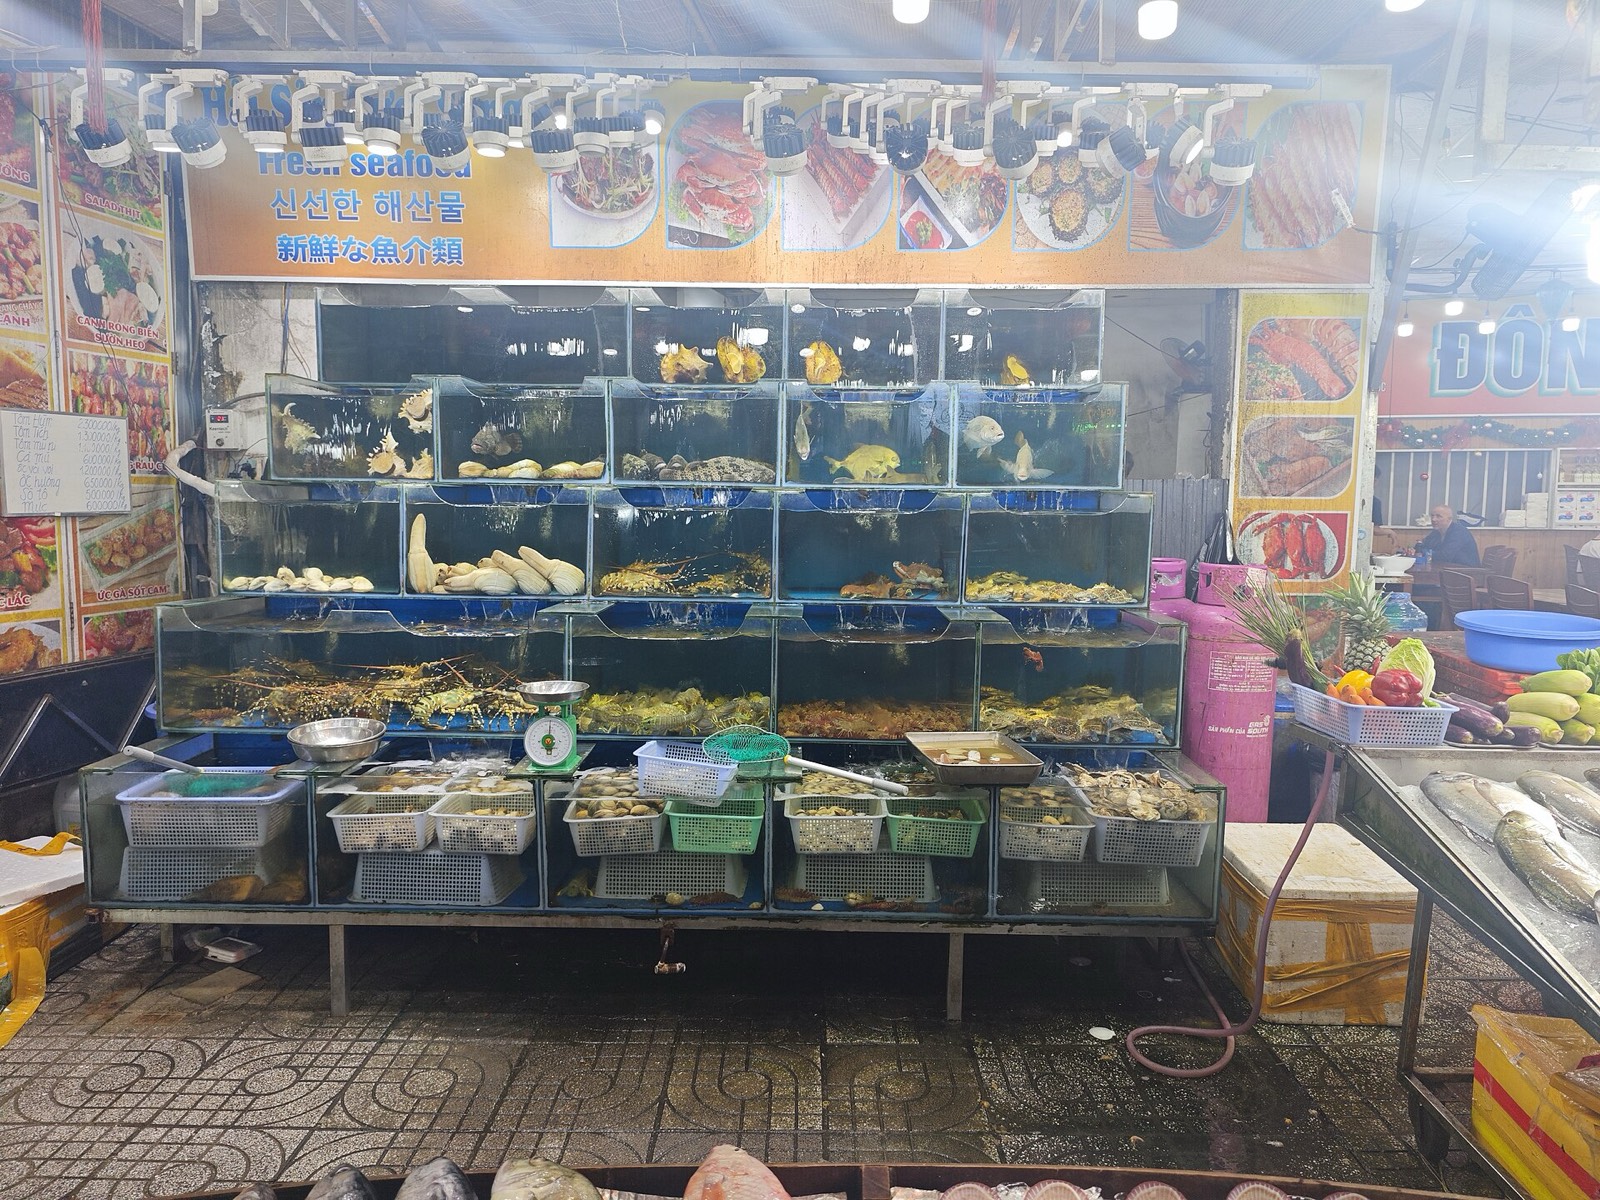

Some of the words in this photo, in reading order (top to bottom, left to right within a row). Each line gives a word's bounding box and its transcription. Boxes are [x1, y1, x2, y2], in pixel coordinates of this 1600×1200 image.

[85, 193, 119, 212] SALAD
[270, 188, 362, 221] 신선한
[373, 189, 466, 224] 해산물
[276, 233, 465, 266] 新鮮な魚介類
[77, 316, 107, 330] CANH
[108, 321, 136, 335] RONG
[125, 338, 146, 349] HEO
[113, 587, 127, 599] GÀ
[147, 585, 168, 596] CAM
